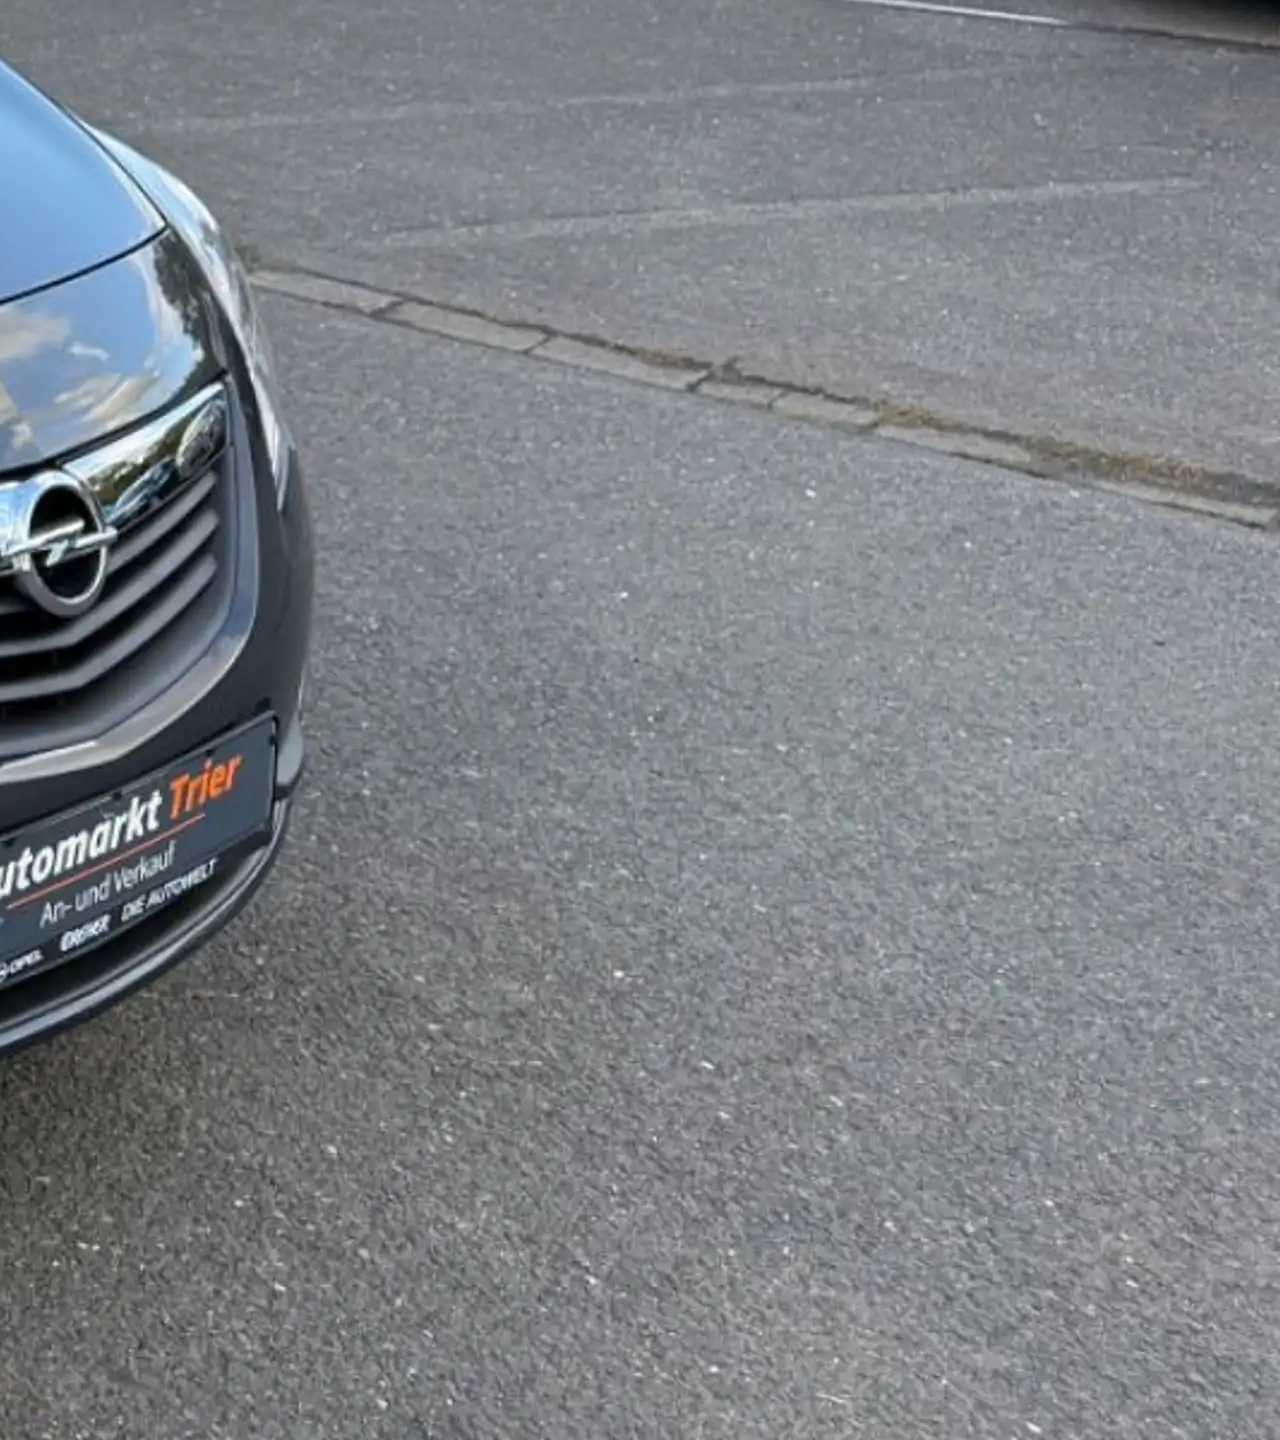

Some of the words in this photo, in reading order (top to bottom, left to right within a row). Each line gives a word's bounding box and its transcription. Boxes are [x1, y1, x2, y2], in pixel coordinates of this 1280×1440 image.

[169, 755, 244, 821] Trier
[39, 901, 72, 929] An-
[75, 872, 112, 912] und
[113, 839, 177, 893] Verkauf
